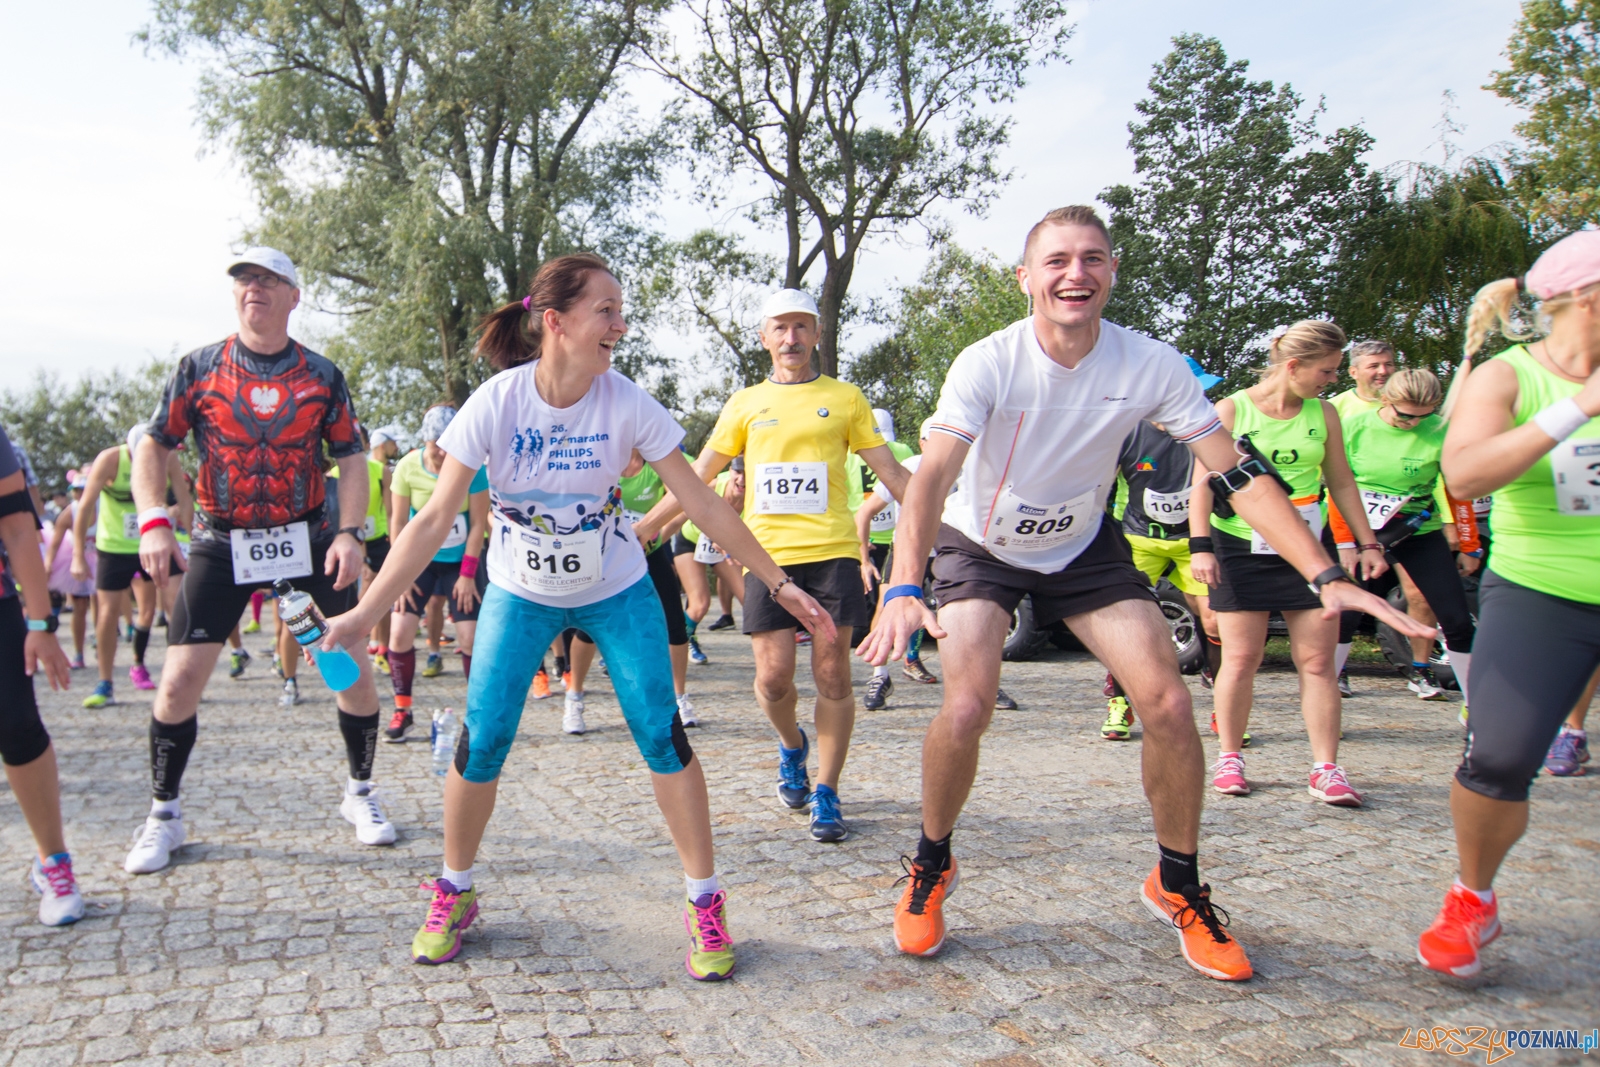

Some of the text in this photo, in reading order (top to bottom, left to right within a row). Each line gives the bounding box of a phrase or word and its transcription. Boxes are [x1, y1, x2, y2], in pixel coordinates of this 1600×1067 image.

[551, 424, 568, 433] 26.
[549, 448, 593, 459] PHILIPS
[548, 460, 601, 470] Piła 2016
[763, 478, 819, 494] 1874
[1015, 515, 1074, 535] 809
[249, 540, 294, 561] 696
[527, 549, 581, 574] 816
[538, 577, 555, 585] BIEG
[556, 574, 593, 586] LECHITÓW
